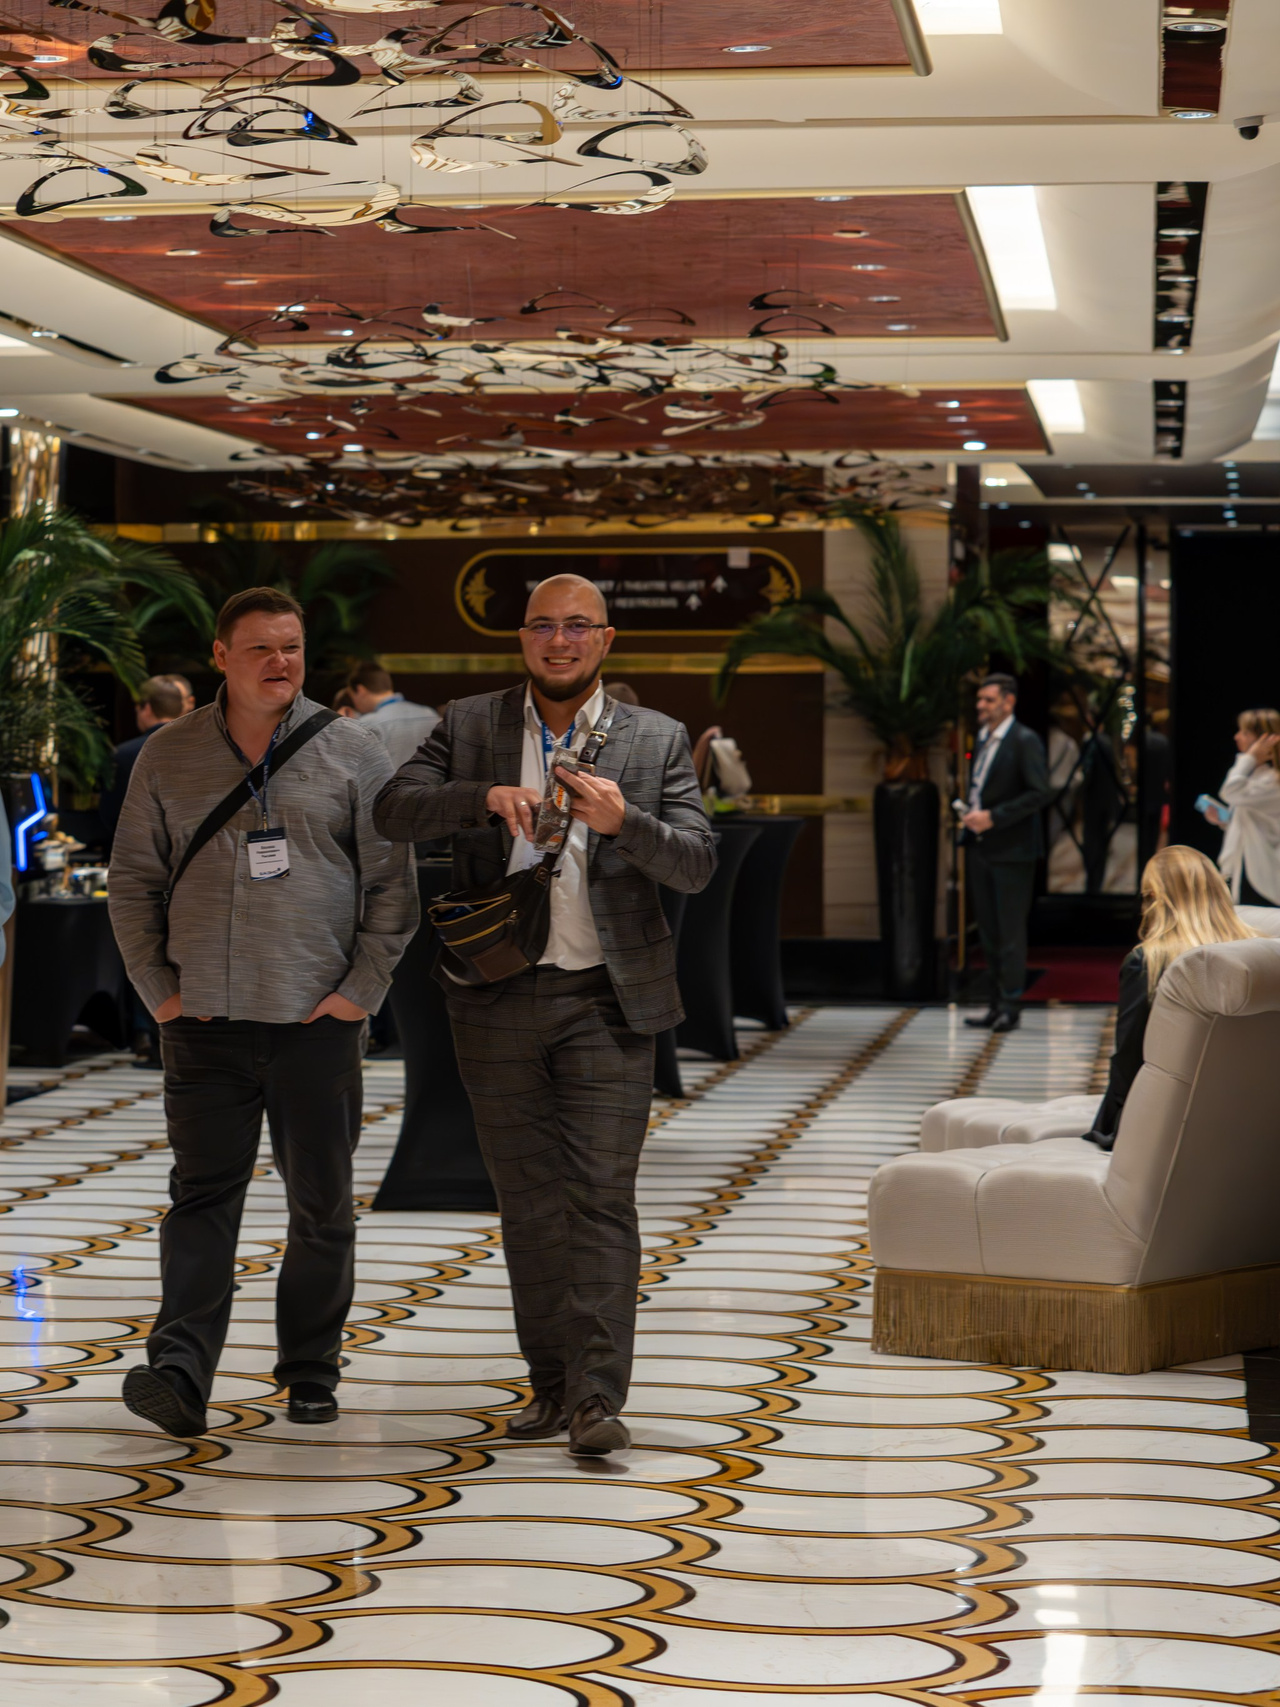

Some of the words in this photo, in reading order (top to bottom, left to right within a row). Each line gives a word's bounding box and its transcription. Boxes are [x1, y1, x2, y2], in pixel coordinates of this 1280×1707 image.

[624, 580, 668, 592] THEATRE
[669, 580, 705, 592] VELVET
[615, 597, 678, 608] RESTROOMS
